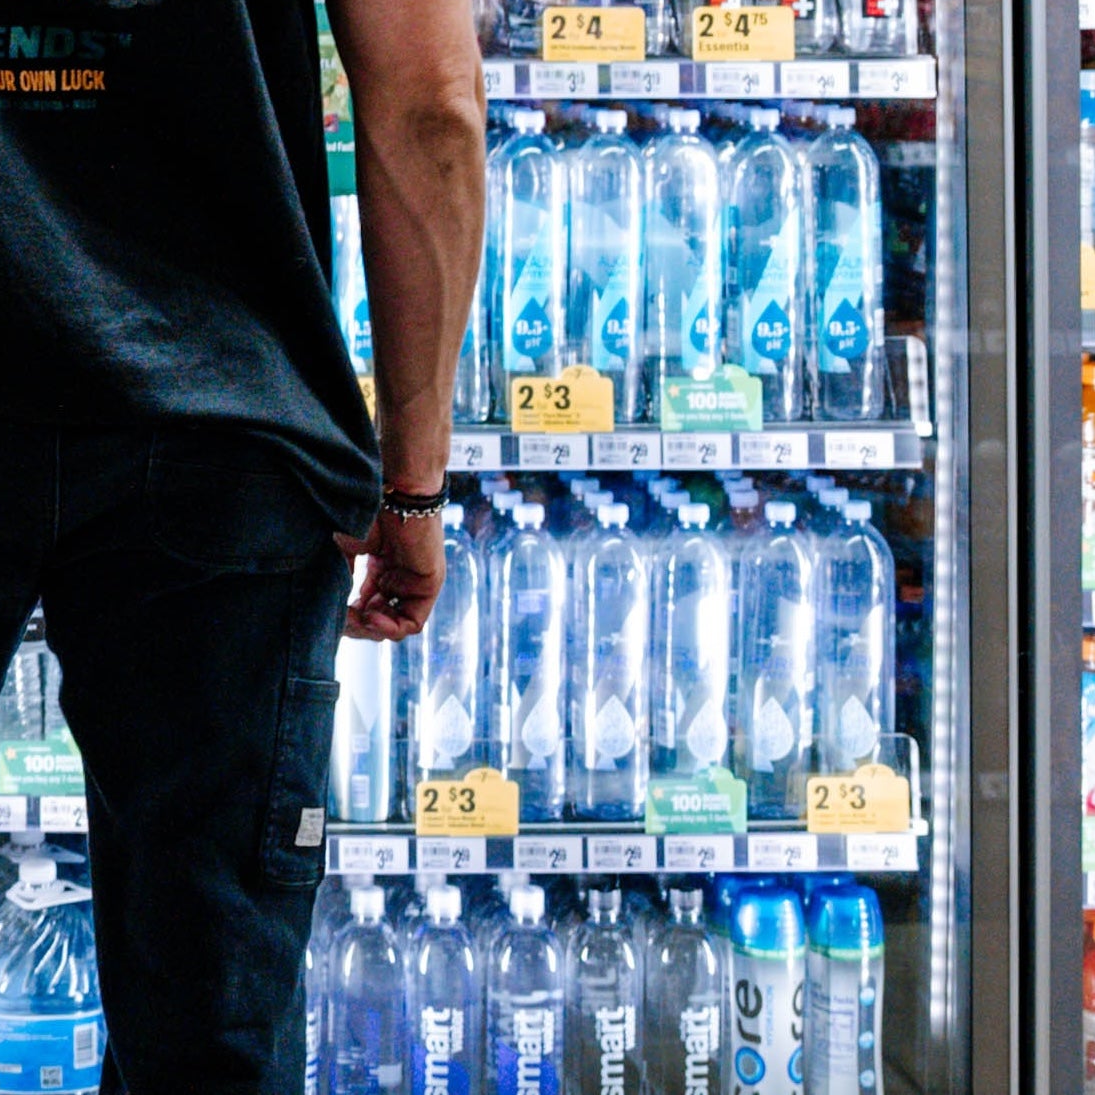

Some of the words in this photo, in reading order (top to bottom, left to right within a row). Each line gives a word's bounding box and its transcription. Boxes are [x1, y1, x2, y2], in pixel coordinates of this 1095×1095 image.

[551, 16, 565, 39] 2
[577, 14, 602, 39] $4
[699, 14, 713, 37] 2
[699, 41, 750, 52] Essentia
[19, 69, 57, 92] OWN
[61, 68, 105, 91] LUCK
[519, 386, 534, 410] 2
[544, 384, 571, 409] $3
[687, 392, 717, 409] 100
[24, 755, 54, 773] 100
[423, 789, 439, 812] 2
[449, 787, 476, 812] $3
[671, 794, 701, 812] 100
[815, 785, 830, 810] 2
[840, 784, 866, 809] $3
